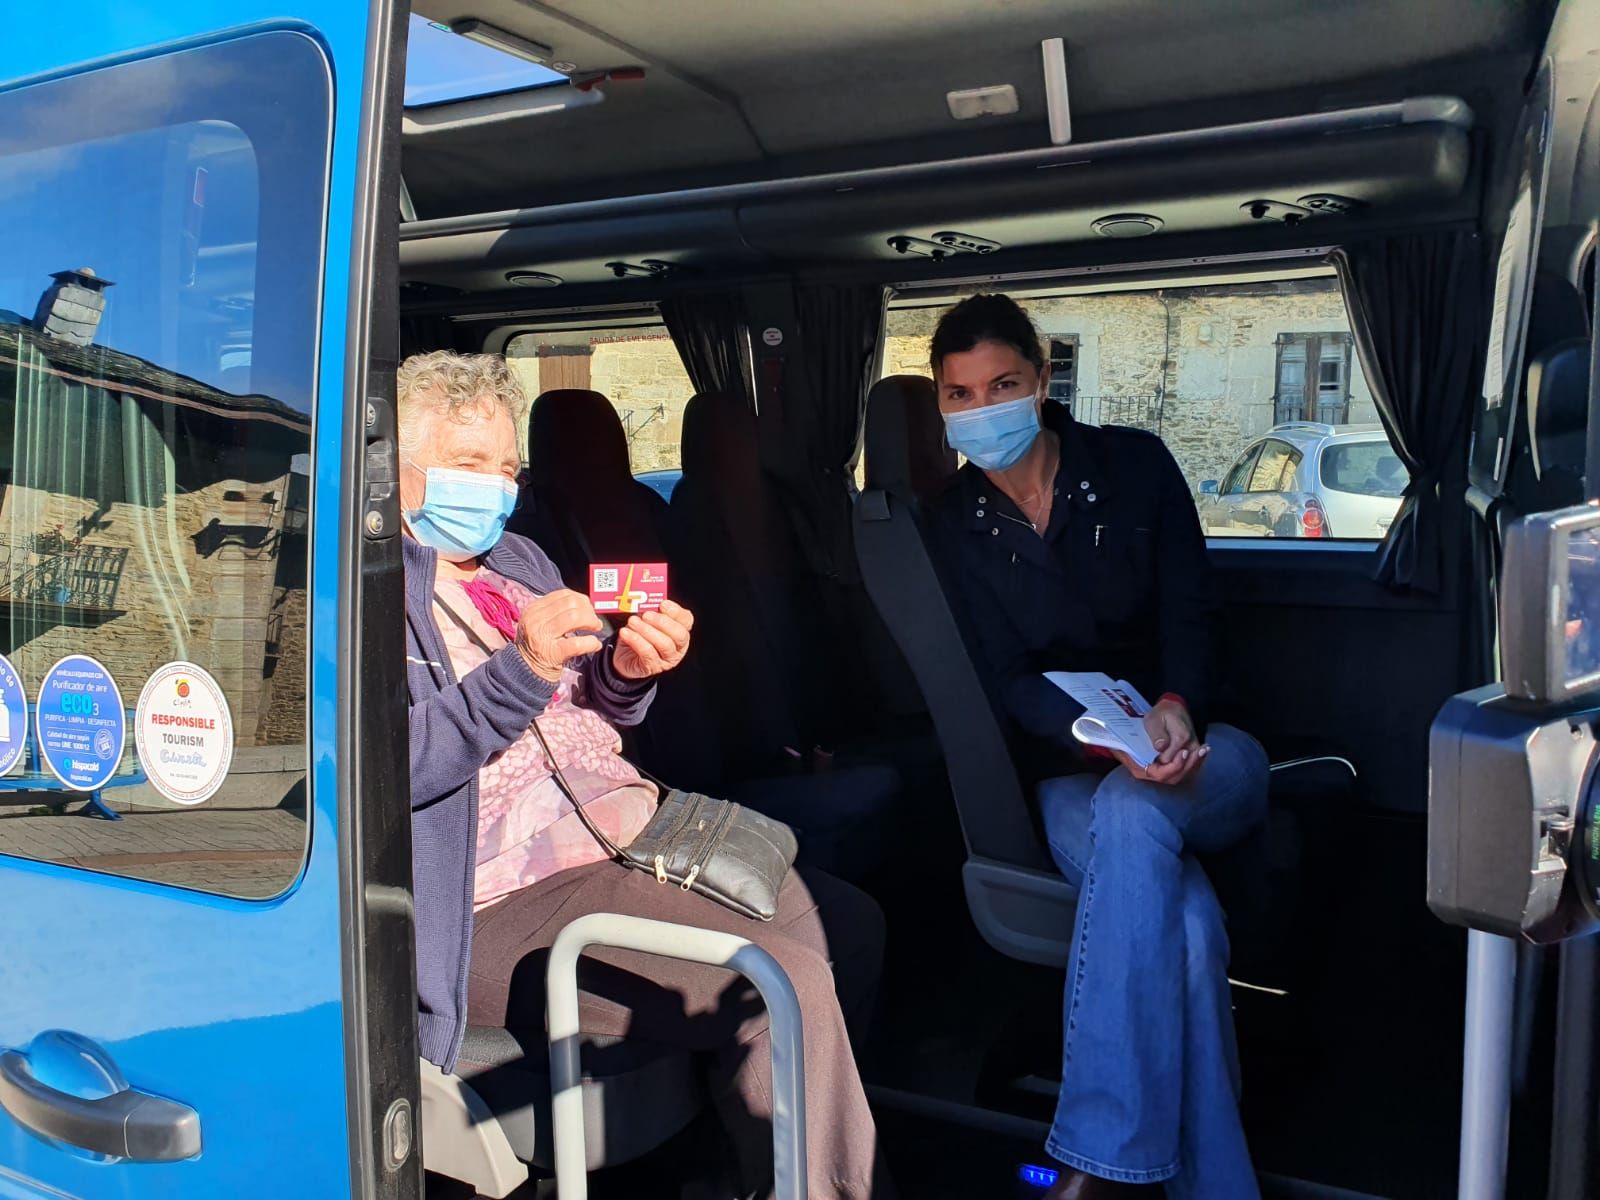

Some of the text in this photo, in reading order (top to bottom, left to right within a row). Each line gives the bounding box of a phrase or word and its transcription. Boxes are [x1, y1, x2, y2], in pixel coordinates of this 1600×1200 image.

[589, 334, 673, 345] SALIDA DE EMERGENCI
[52, 680, 107, 692] Purificador de aire
[151, 713, 216, 730] RESPONSIBLE
[162, 733, 205, 748] TOURISM
